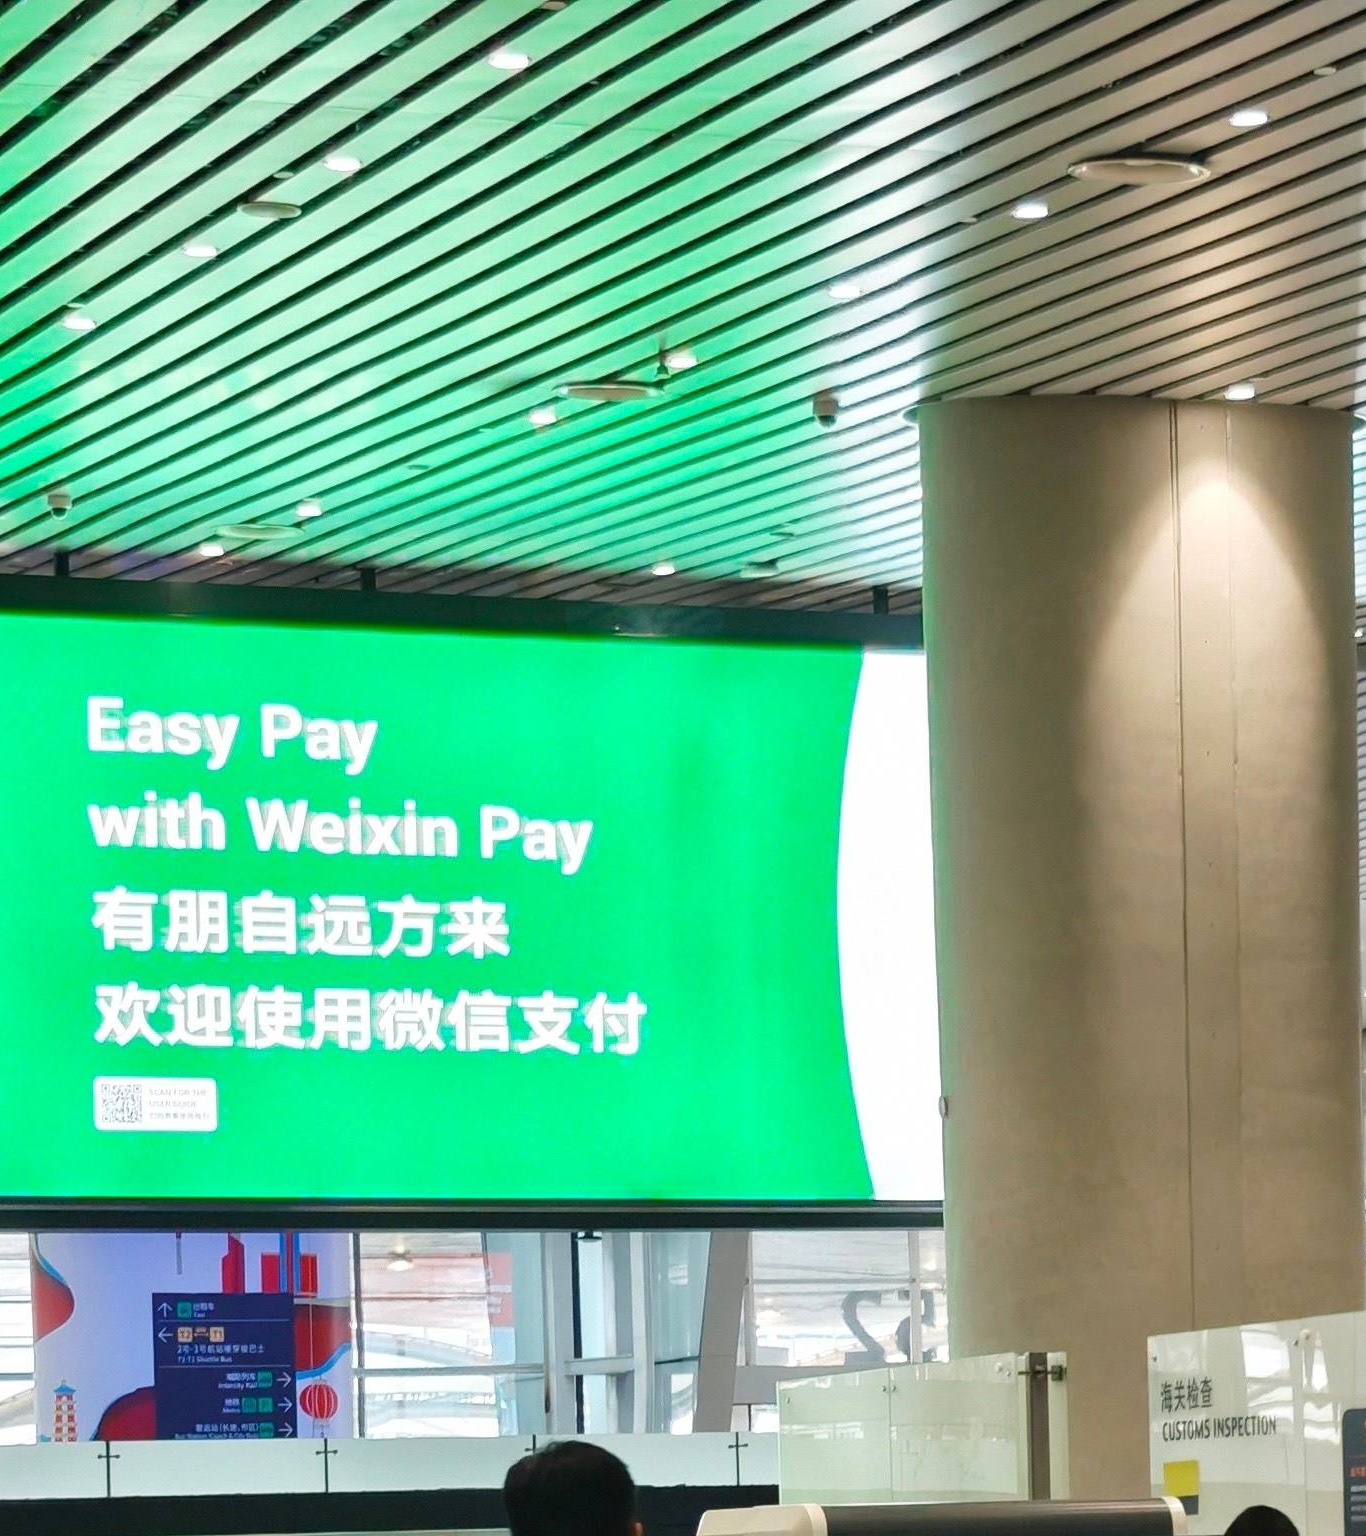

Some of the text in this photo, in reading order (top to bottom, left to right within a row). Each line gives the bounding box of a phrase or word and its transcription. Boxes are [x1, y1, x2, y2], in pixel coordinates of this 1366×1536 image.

[86, 695, 378, 775] Easy Pay
[86, 789, 594, 874] with Weixin Pay
[91, 885, 511, 959] 有朋自远方来
[93, 980, 648, 1056] 欢迎使用微信支付
[1160, 1376, 1213, 1413] 海关检查
[1162, 1415, 1277, 1442] CUSTOMS INSPECTION
